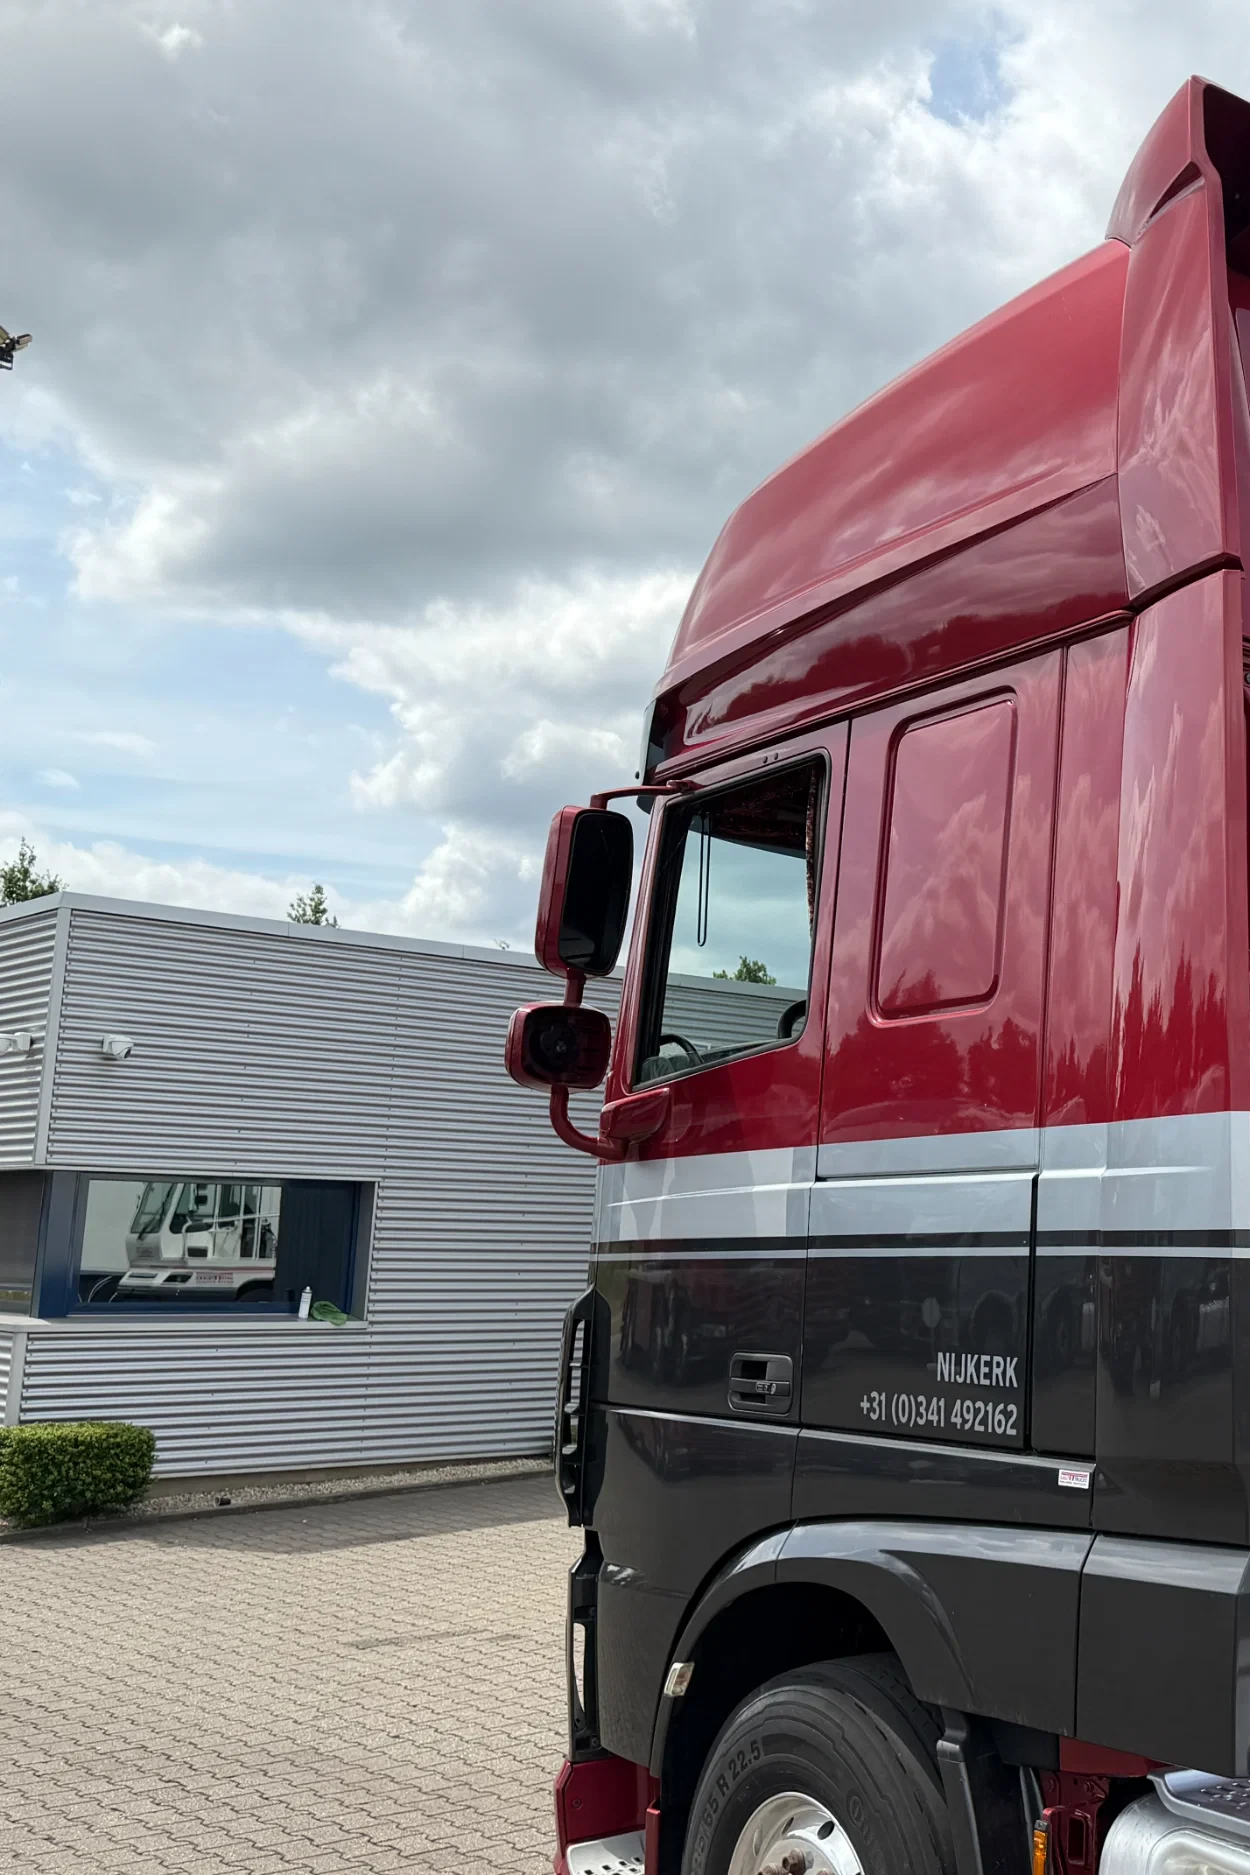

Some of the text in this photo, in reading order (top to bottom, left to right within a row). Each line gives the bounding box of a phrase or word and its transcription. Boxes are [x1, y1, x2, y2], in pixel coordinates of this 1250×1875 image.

[937, 1351, 1018, 1388] NIJKERK
[860, 1391, 1018, 1436] +31 (0)341 492162
[716, 1773, 730, 1798] R
[728, 1739, 761, 1781] 22.5
